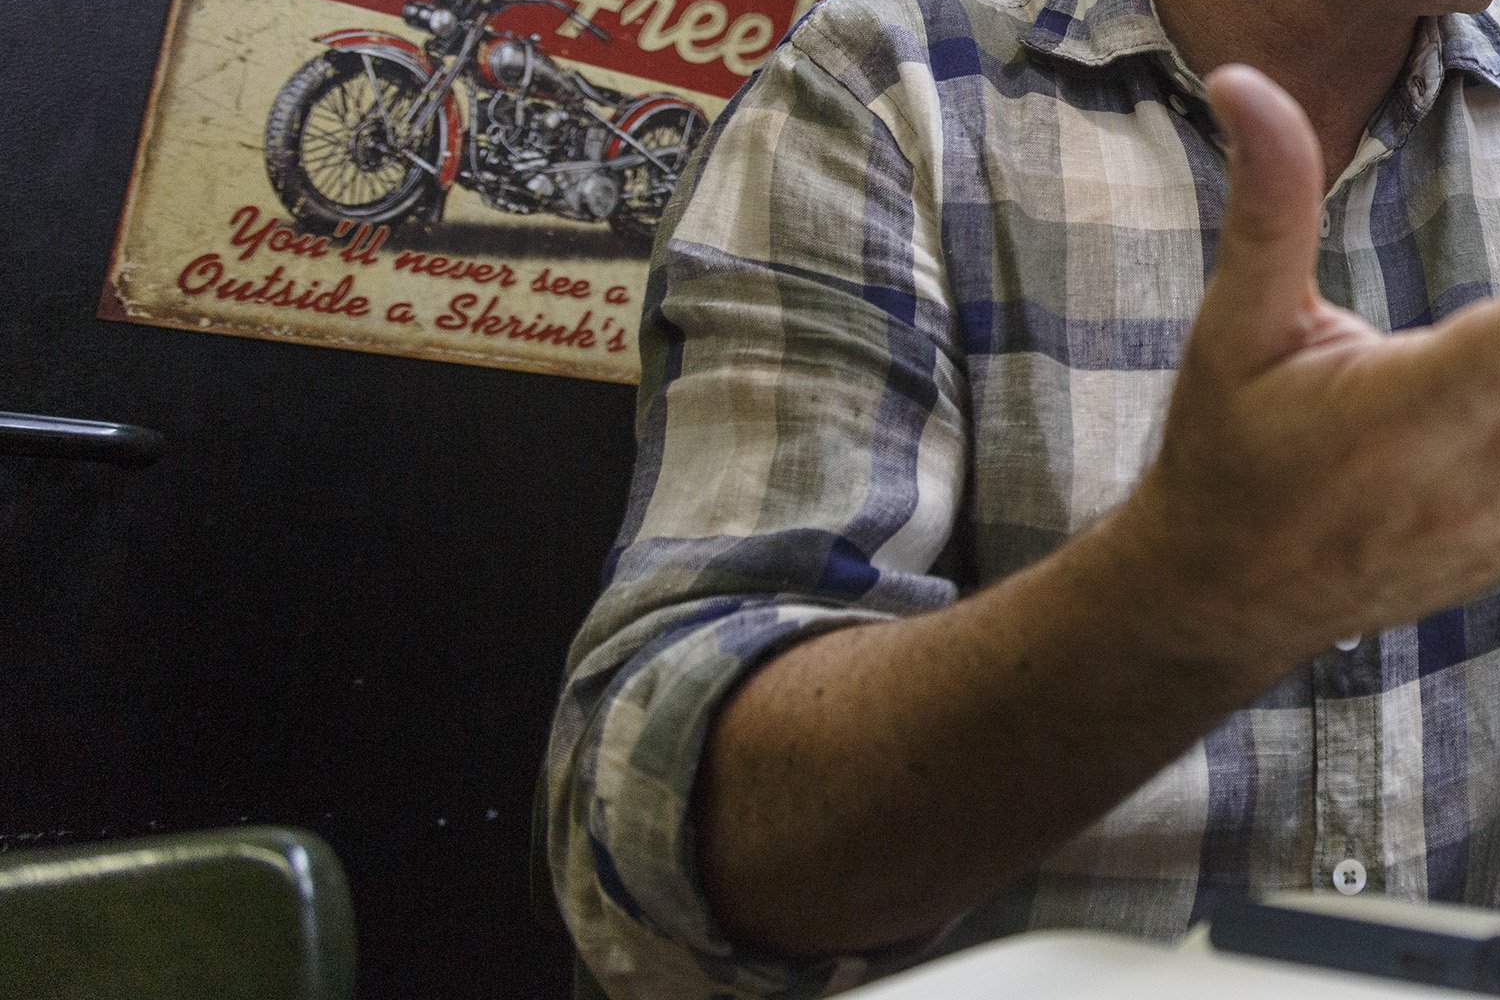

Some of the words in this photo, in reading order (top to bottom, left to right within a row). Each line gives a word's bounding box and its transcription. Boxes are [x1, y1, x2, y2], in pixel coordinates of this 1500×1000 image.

[176, 252, 370, 319] Outside
[385, 299, 416, 327] a
[230, 205, 390, 264] You'll
[395, 248, 517, 286] never
[530, 265, 593, 299] see
[603, 284, 632, 306] a
